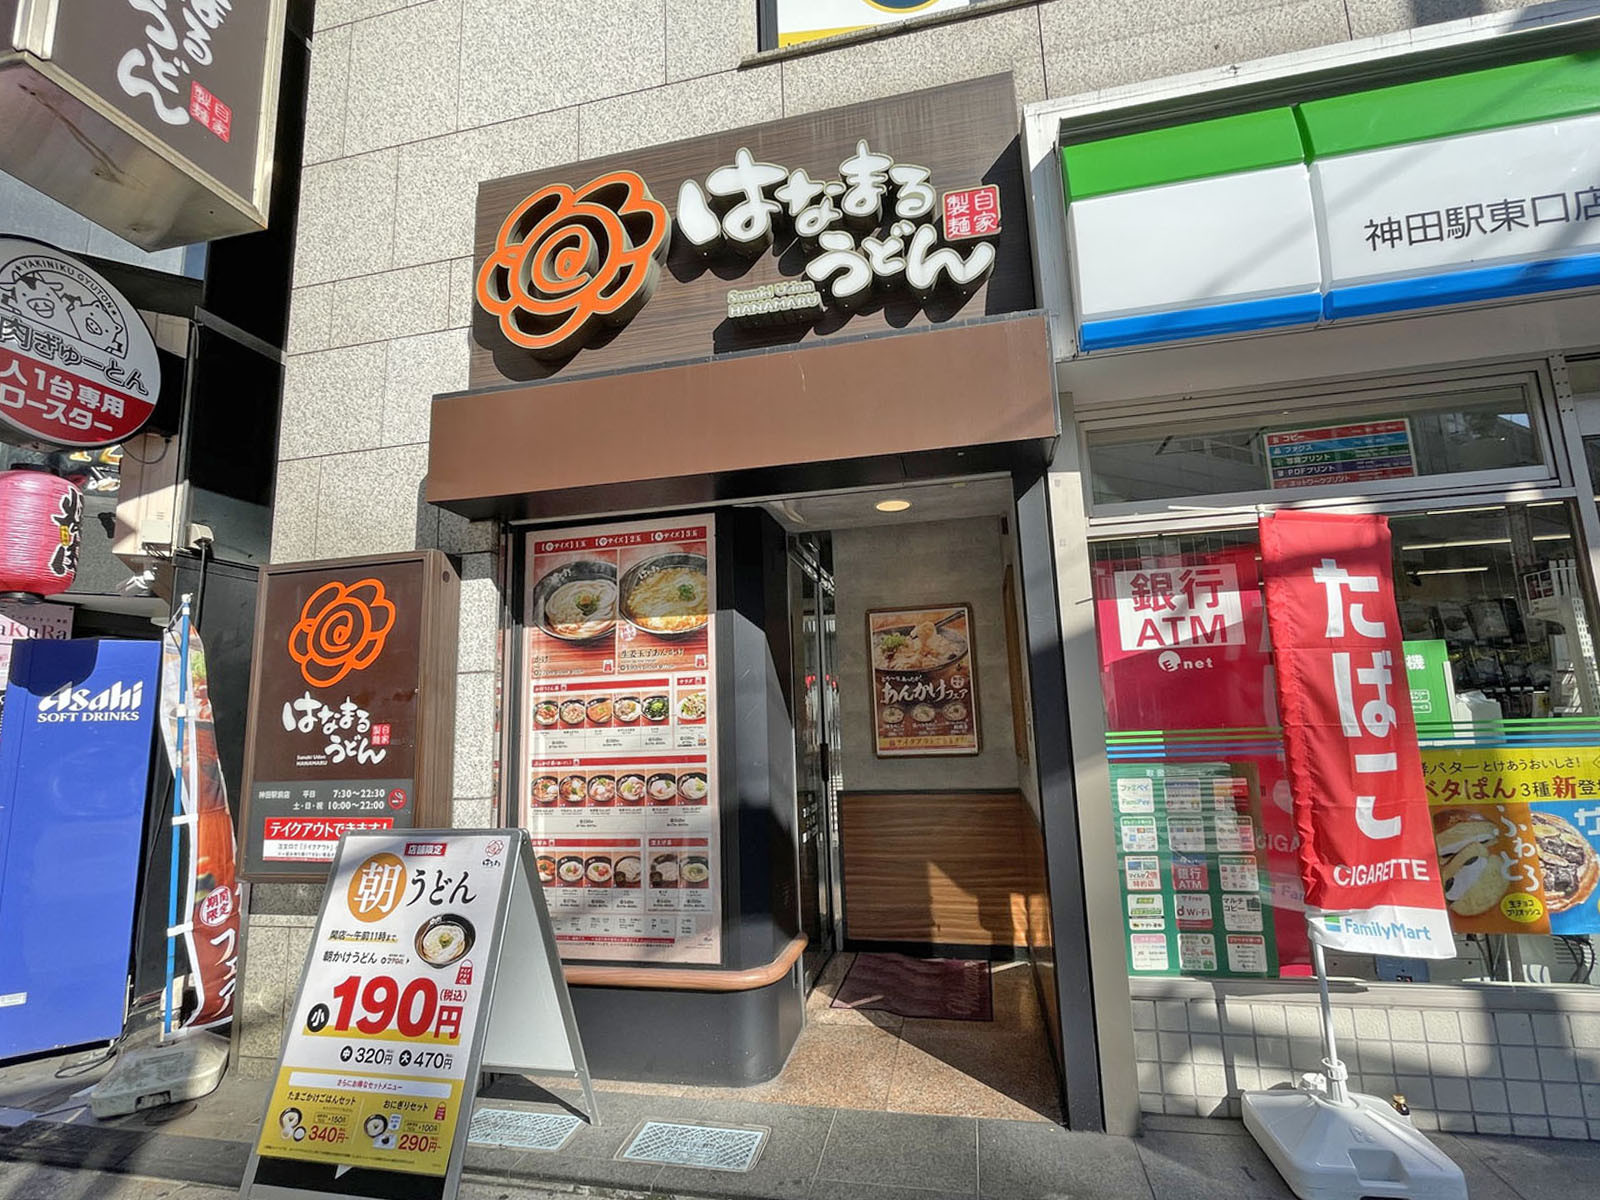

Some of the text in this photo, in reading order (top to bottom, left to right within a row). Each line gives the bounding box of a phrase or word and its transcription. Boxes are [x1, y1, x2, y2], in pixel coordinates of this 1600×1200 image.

[676, 138, 937, 246] はなまる
[1363, 185, 1600, 252] 神田駅東口店
[804, 219, 996, 298] うどん
[21, 260, 113, 310] YAKINIKU GYUTON
[728, 292, 820, 317] HANAMARU
[1129, 568, 1225, 613] 銀行
[1136, 614, 1229, 648] ATM
[38, 680, 144, 712] Asahi
[1311, 557, 1403, 841] たばこ
[37, 711, 140, 723] SOFT DRINKS
[282, 690, 371, 735] はなまる
[324, 734, 387, 765] うどん
[302, 790, 316, 799] 平日
[407, 844, 442, 856] 店舗限定
[1176, 867, 1202, 880] 銀行
[1178, 880, 1203, 890] ATM
[1332, 858, 1431, 888] CIGARETTE
[353, 861, 477, 914] 朝 うどん
[1223, 896, 1244, 905] マルチ
[1224, 904, 1246, 912] コピー
[1344, 916, 1432, 942] FamilyMart
[322, 950, 378, 965] 朝かけうどん
[439, 988, 468, 1003] (税込)
[310, 1007, 326, 1028] 小
[355, 1048, 394, 1065] 320円
[413, 1052, 453, 1070] 470円
[287, 1090, 429, 1112] たまごかけごはんセット おにぎりセット
